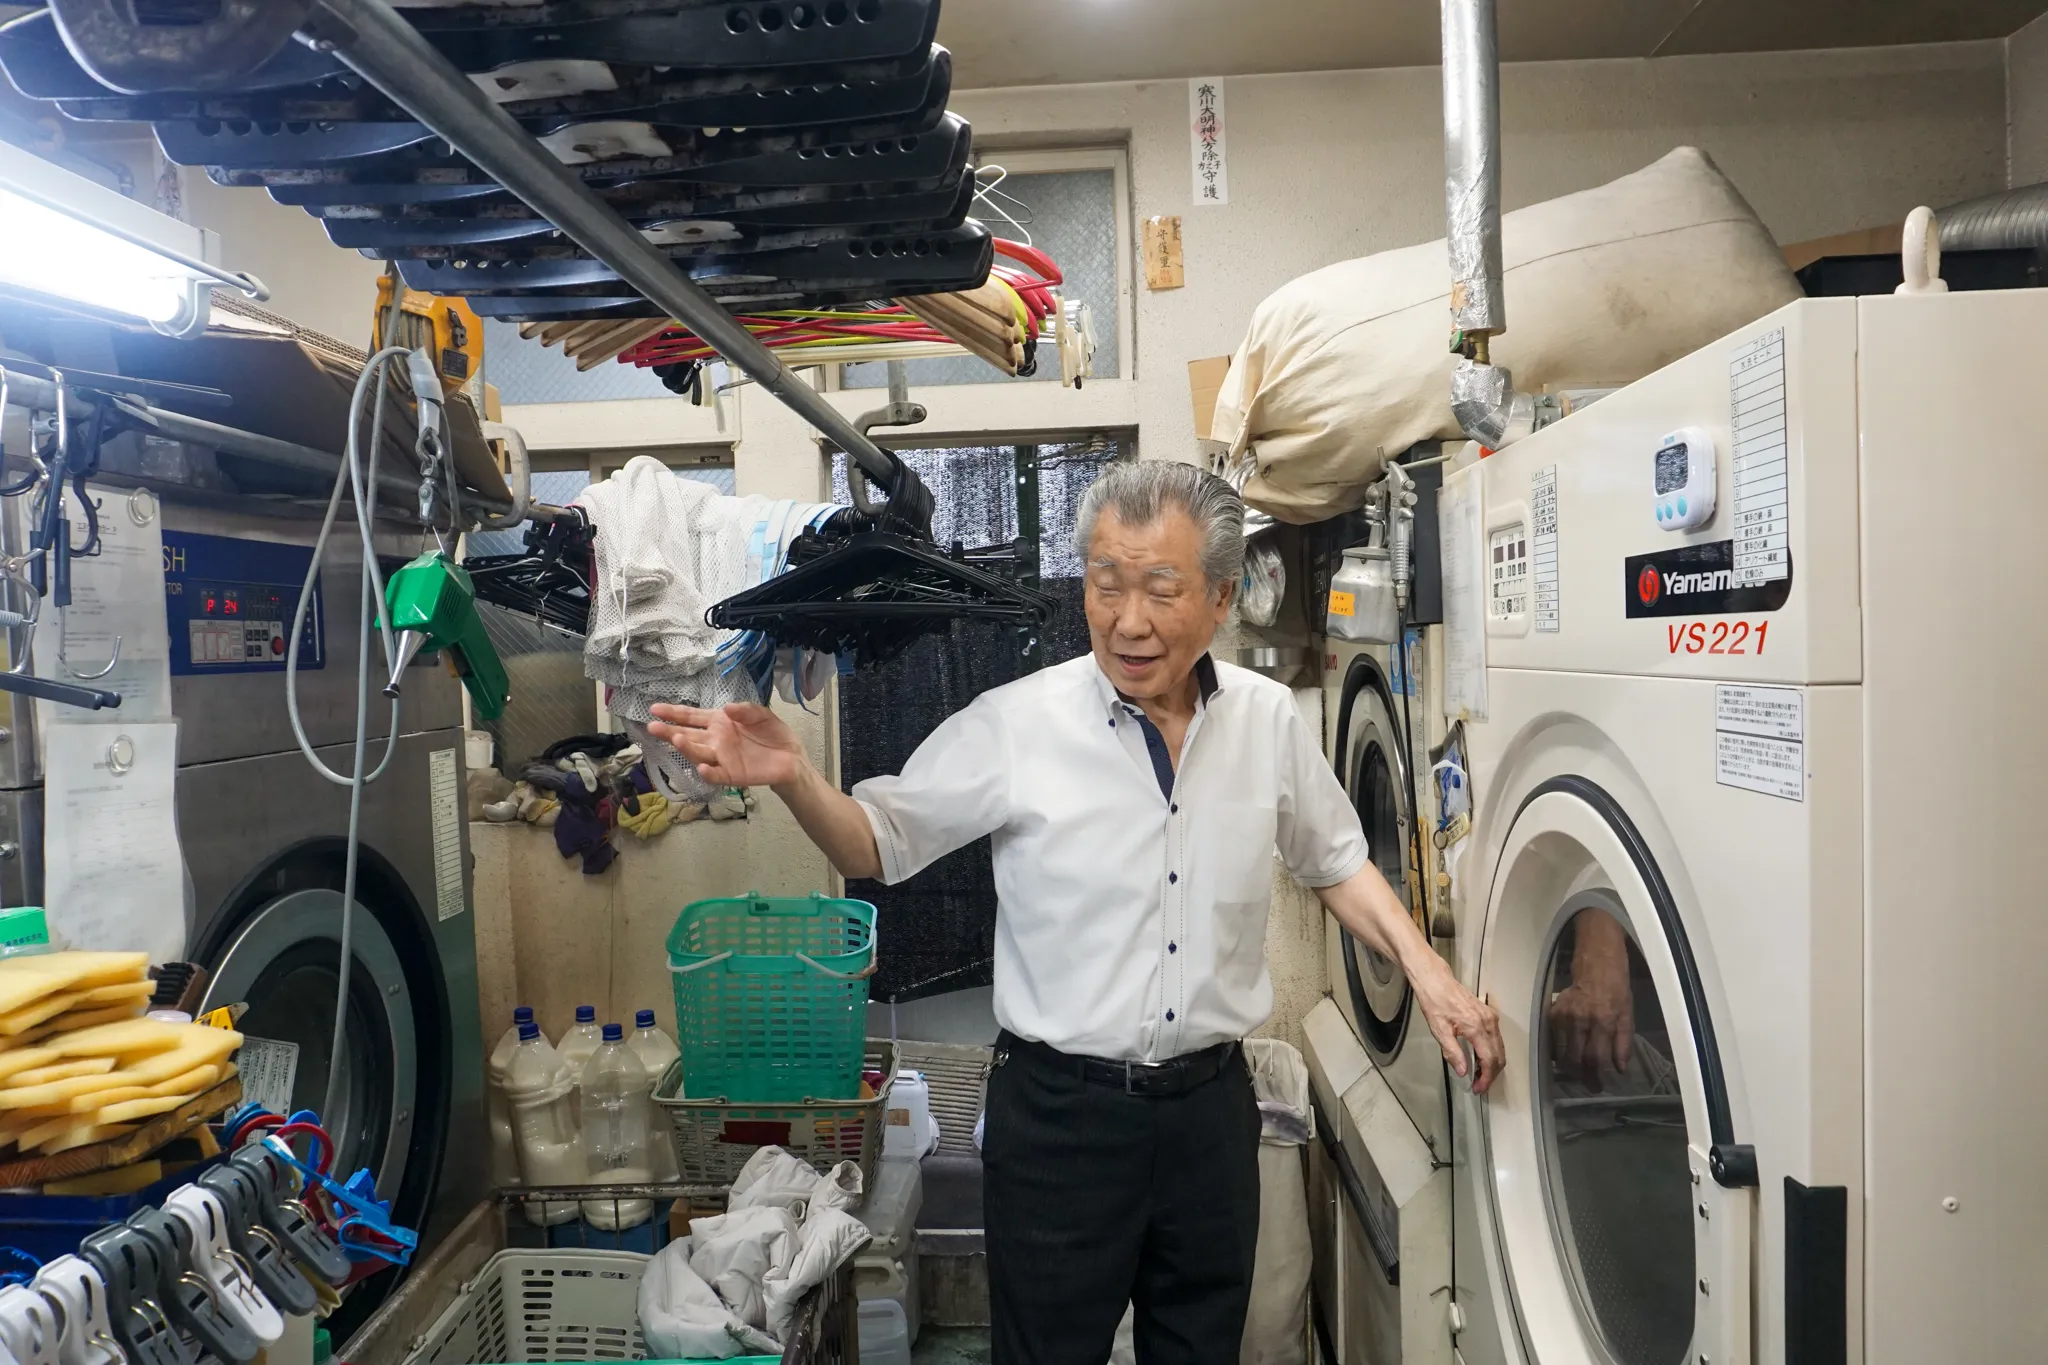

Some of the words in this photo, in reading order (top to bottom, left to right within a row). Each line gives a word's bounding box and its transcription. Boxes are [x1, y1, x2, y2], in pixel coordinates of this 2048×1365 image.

[207, 599, 214, 613] P
[224, 600, 237, 614] 24
[1668, 620, 1768, 655] VS221
